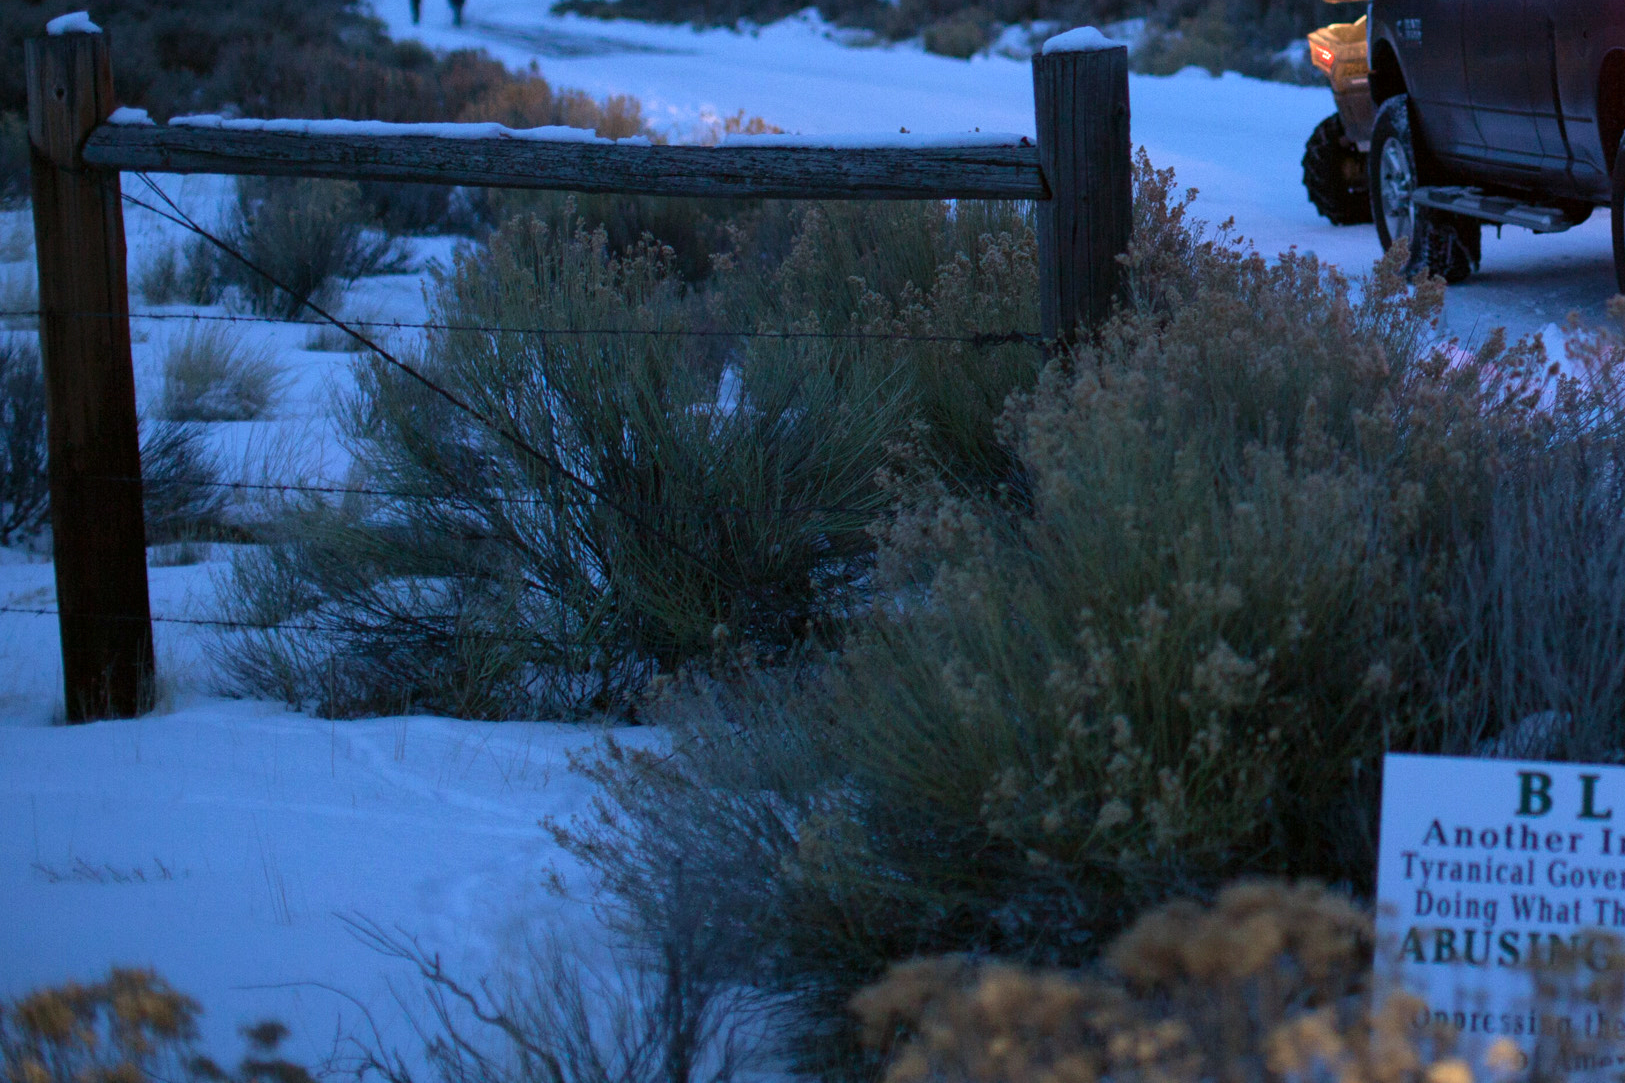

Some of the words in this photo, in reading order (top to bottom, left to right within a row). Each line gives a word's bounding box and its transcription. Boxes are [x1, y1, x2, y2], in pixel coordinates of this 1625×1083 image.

[1422, 817, 1584, 853] Another
[1401, 850, 1534, 889] Tyranical
[1415, 888, 1499, 929] Doing
[1510, 892, 1582, 925] What
